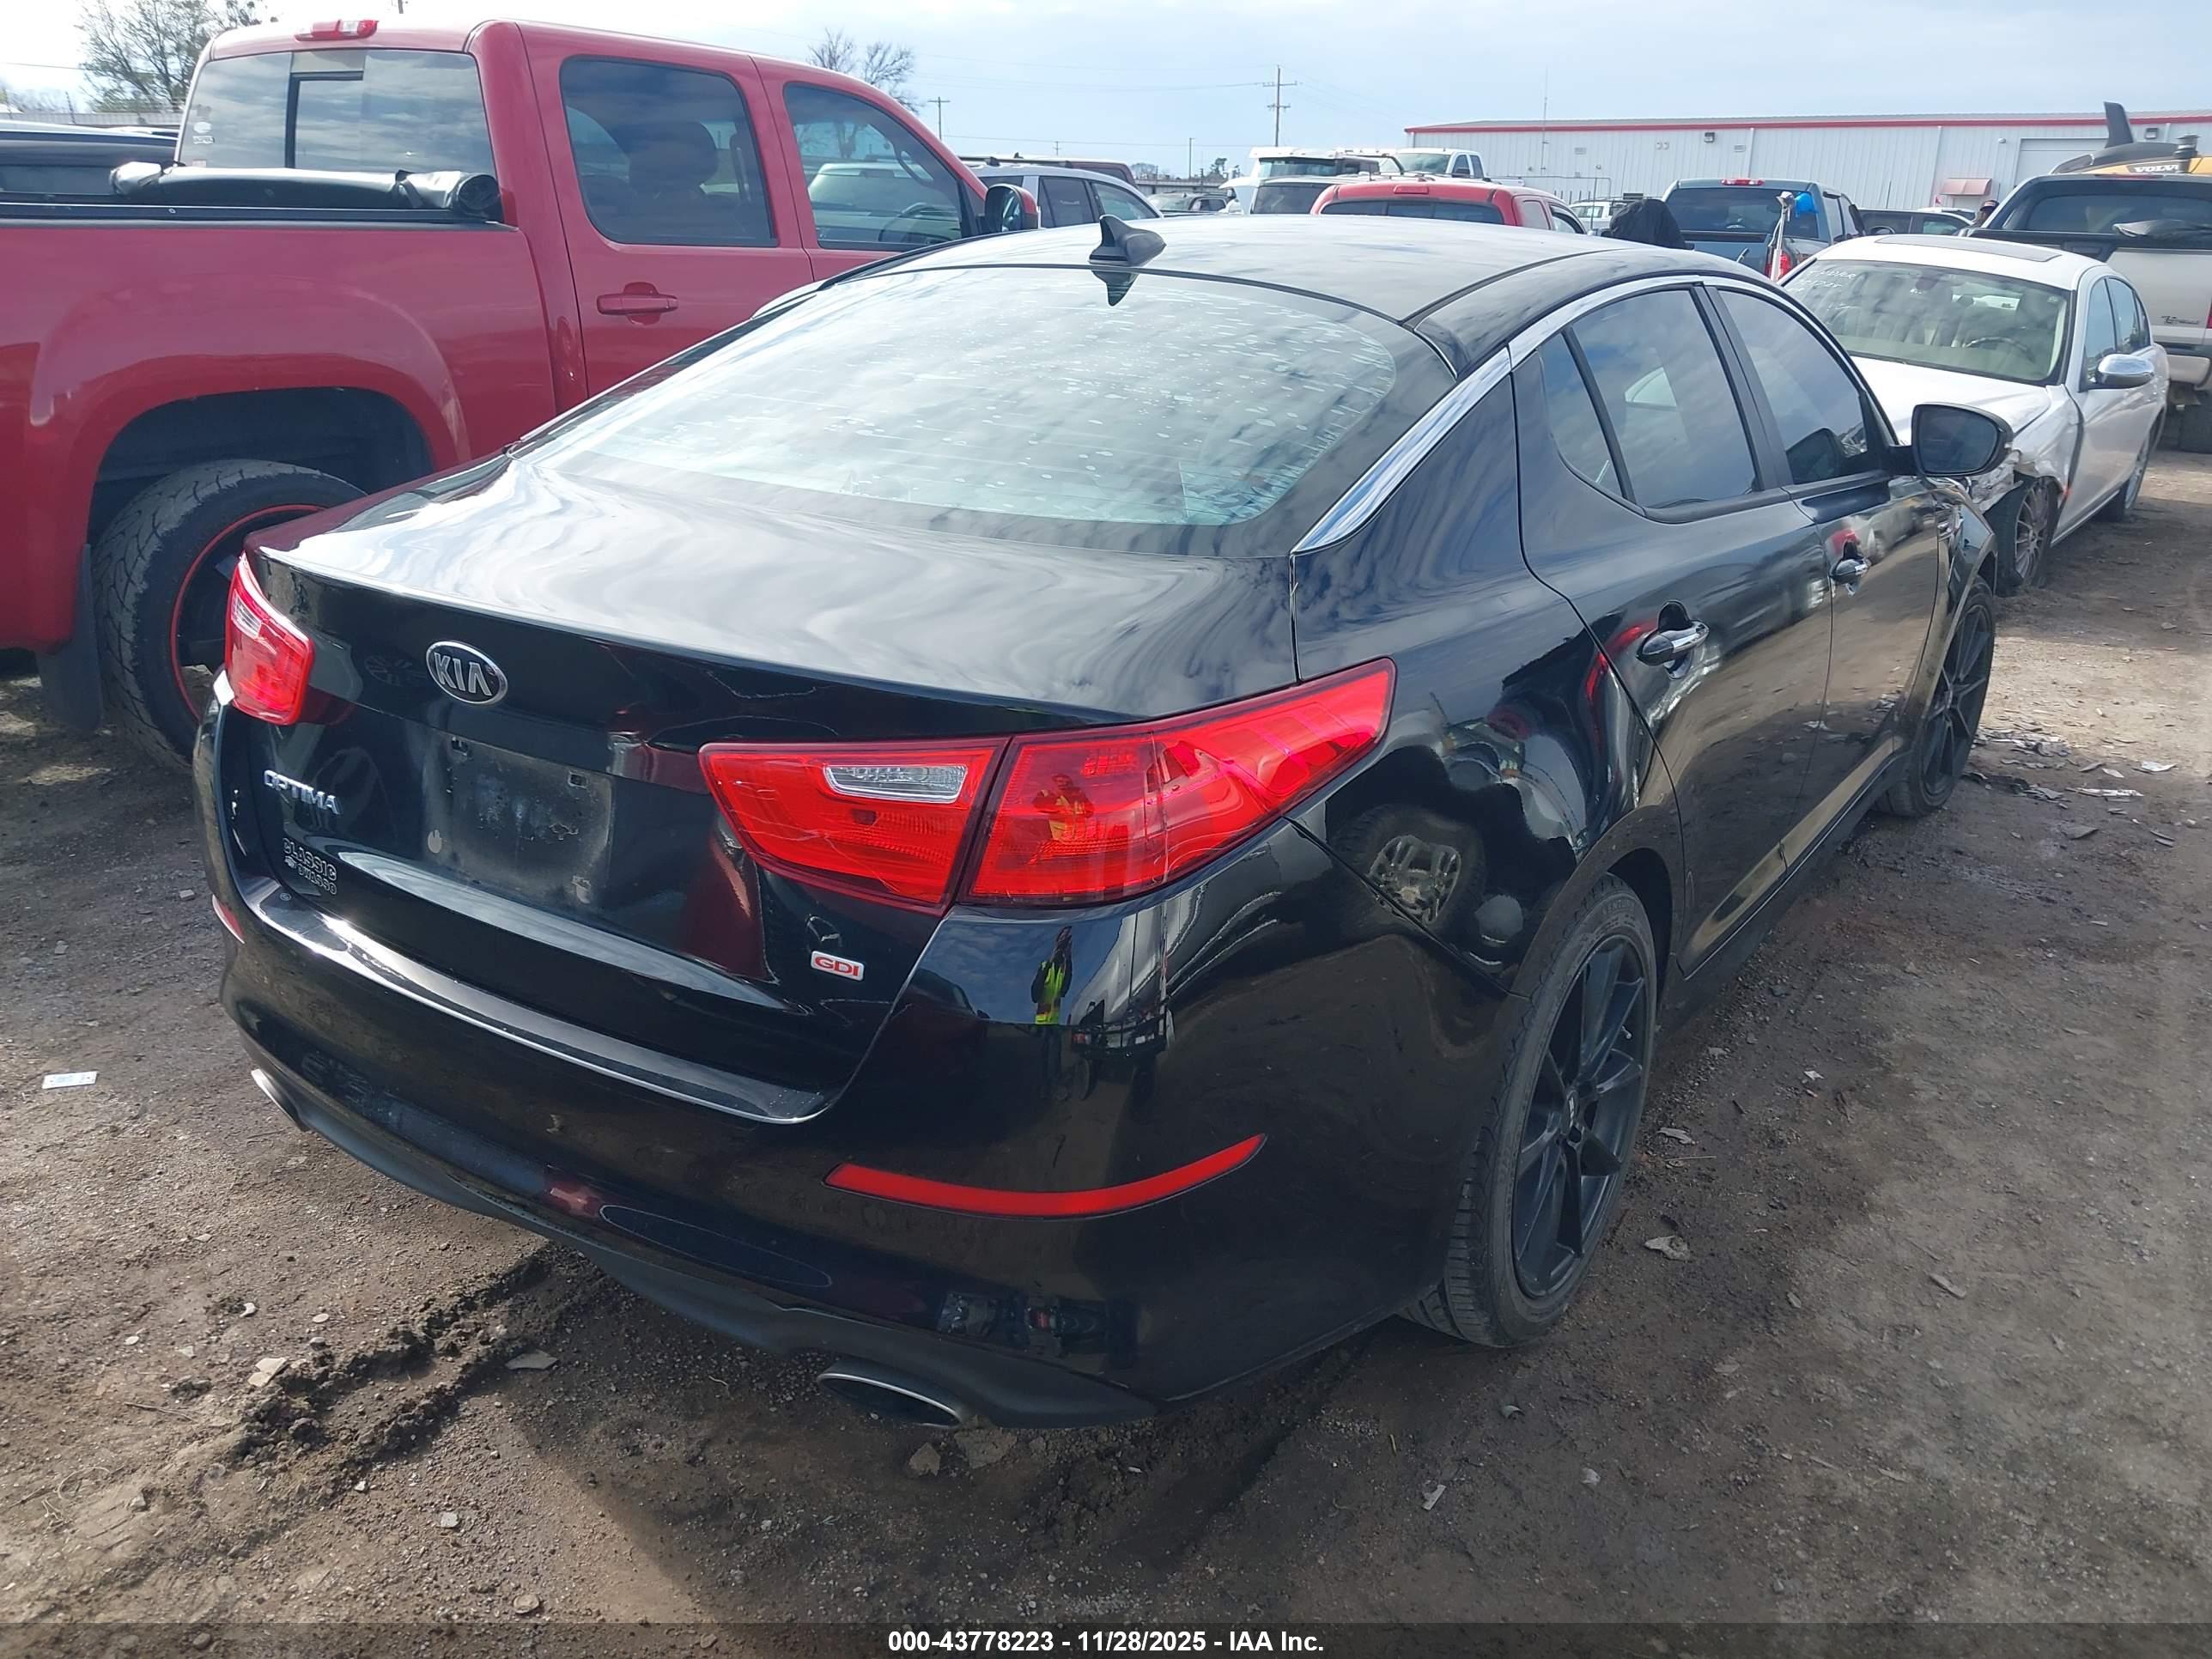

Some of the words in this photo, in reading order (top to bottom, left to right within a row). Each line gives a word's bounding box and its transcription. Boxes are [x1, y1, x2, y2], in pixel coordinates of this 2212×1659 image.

[2134, 164, 2179, 173] VOLV
[434, 652, 493, 696] KIA
[264, 769, 342, 815] OPTIMA
[283, 837, 337, 881] CLASSIC
[815, 956, 860, 976] GDI
